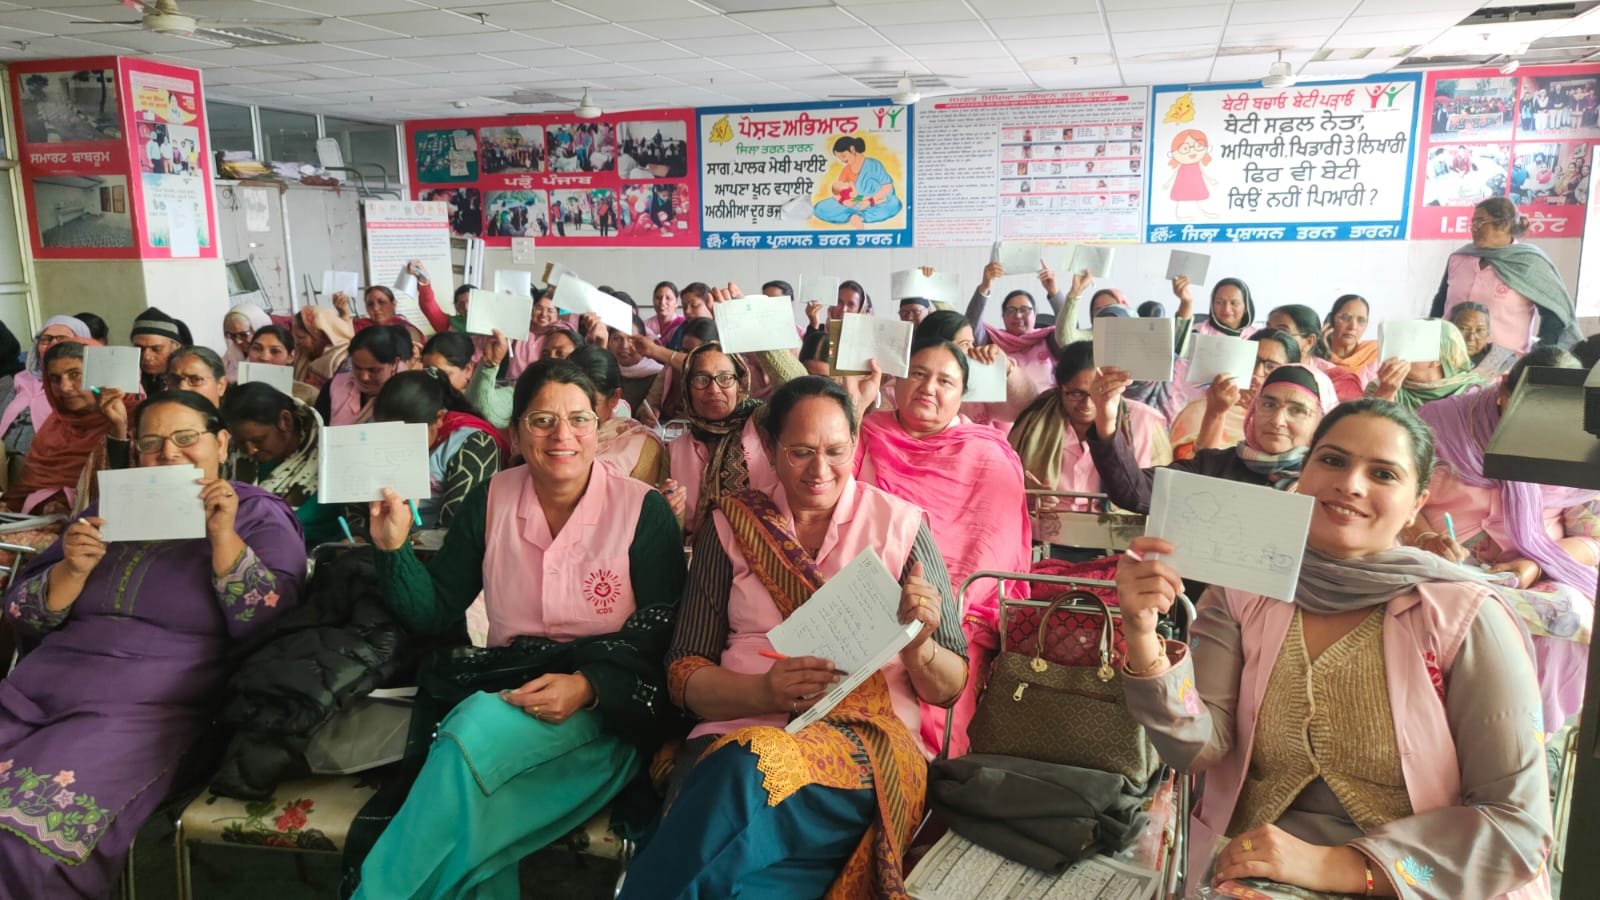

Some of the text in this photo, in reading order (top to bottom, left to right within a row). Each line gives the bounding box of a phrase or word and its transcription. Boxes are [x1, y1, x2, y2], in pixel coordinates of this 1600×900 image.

[1221, 92, 1250, 111] ਬੇਟੀ
[1292, 89, 1319, 108] ਬੇਟੀ
[782, 112, 859, 136] ਅਭਿਆਨ
[1224, 112, 1260, 134] ਬੇਟੀ
[542, 174, 592, 186] ਪੰਜਾਬ
[1243, 158, 1361, 183] ਫਿਰ ਵੀ ਬੇਟੀ
[714, 183, 750, 196] ਆਪਣਾ
[1228, 187, 1262, 212] ਕਿਉਂ
[1266, 185, 1304, 208] ਨਹੀਂ
[818, 234, 850, 246] ਤਰਨ
[1296, 226, 1338, 240] ਤਰਨ
